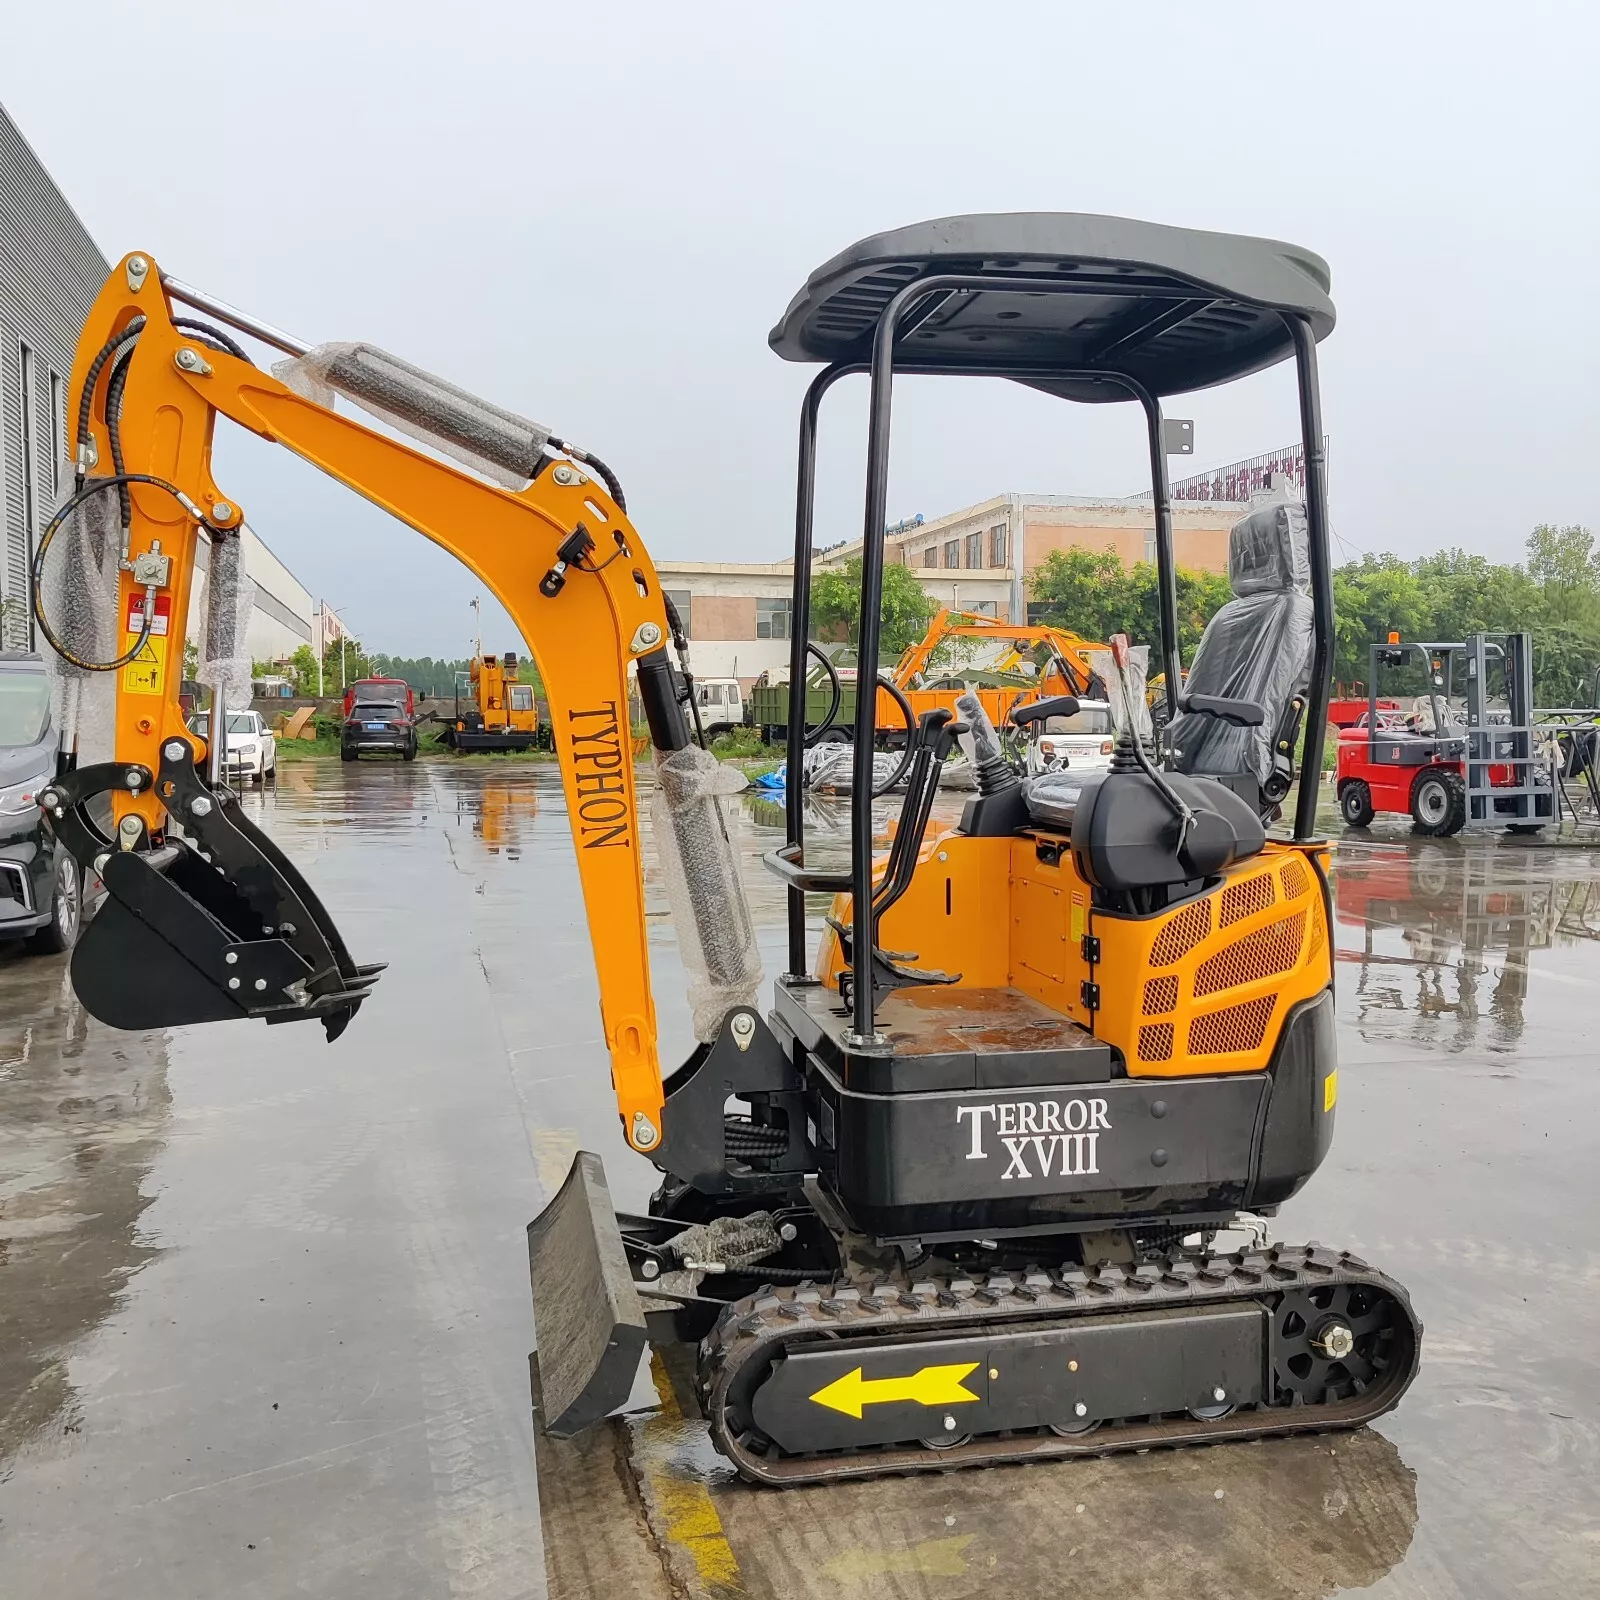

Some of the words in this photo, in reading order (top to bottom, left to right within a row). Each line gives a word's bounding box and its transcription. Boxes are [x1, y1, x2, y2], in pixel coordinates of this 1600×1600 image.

[568, 701, 630, 849] TYPHON
[956, 1098, 1113, 1160] TERROR
[1000, 1132, 1100, 1180] XVIII
